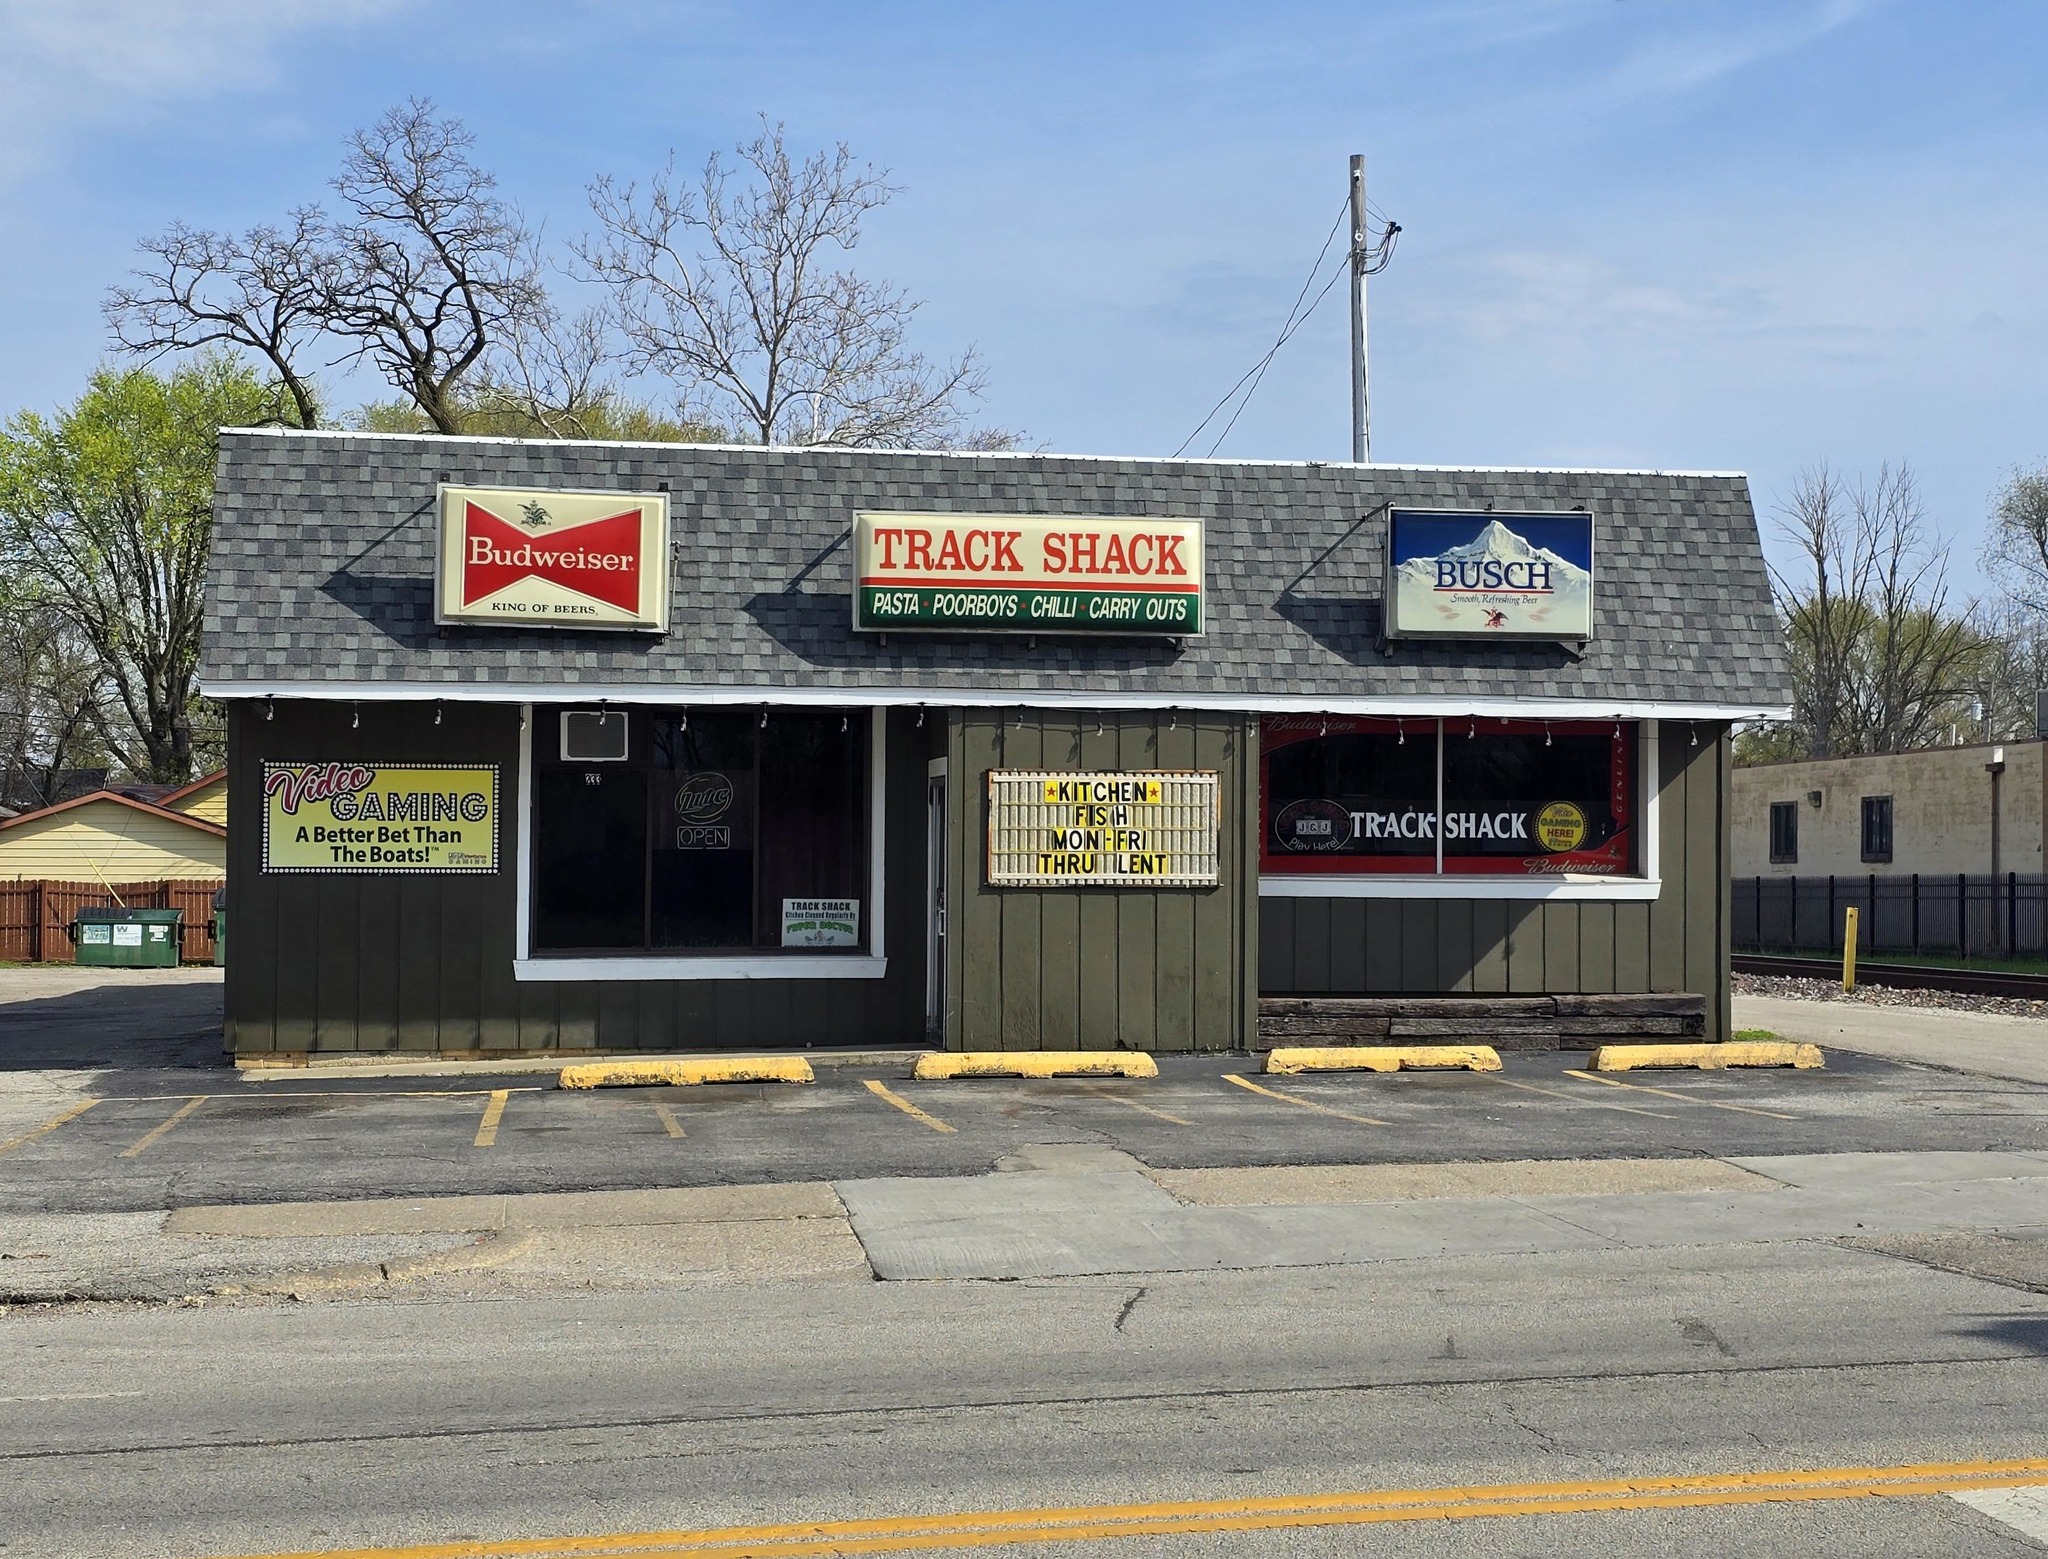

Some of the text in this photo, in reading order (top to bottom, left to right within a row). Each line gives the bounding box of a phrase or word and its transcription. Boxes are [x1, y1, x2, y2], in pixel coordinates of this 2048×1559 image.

[468, 536, 634, 572] Budweiser
[874, 528, 1187, 576] TRACK SHACK
[1434, 560, 1553, 590] BUSCH
[492, 602, 596, 615] KING OF BEERS
[873, 592, 1187, 621] PASTA POORBOYS CHILLI CARRY OUTS
[1450, 594, 1538, 606] Smooth, Refreshing Beer
[265, 762, 375, 815] Video
[1058, 781, 1147, 802] KITCHEN
[330, 792, 488, 822] GAMING
[1075, 805, 1128, 826] FISH
[1350, 811, 1528, 839] TRACK SHACK
[1540, 818, 1581, 828] GAMING
[1547, 828, 1574, 838] HERE!
[295, 826, 461, 843] A Better Bet Than
[680, 828, 727, 845] OPEN
[330, 845, 367, 863] The
[1040, 853, 1166, 874] THRU LENT
[1522, 858, 1616, 875] Budweiser
[791, 902, 851, 911] TRACK SHACK
